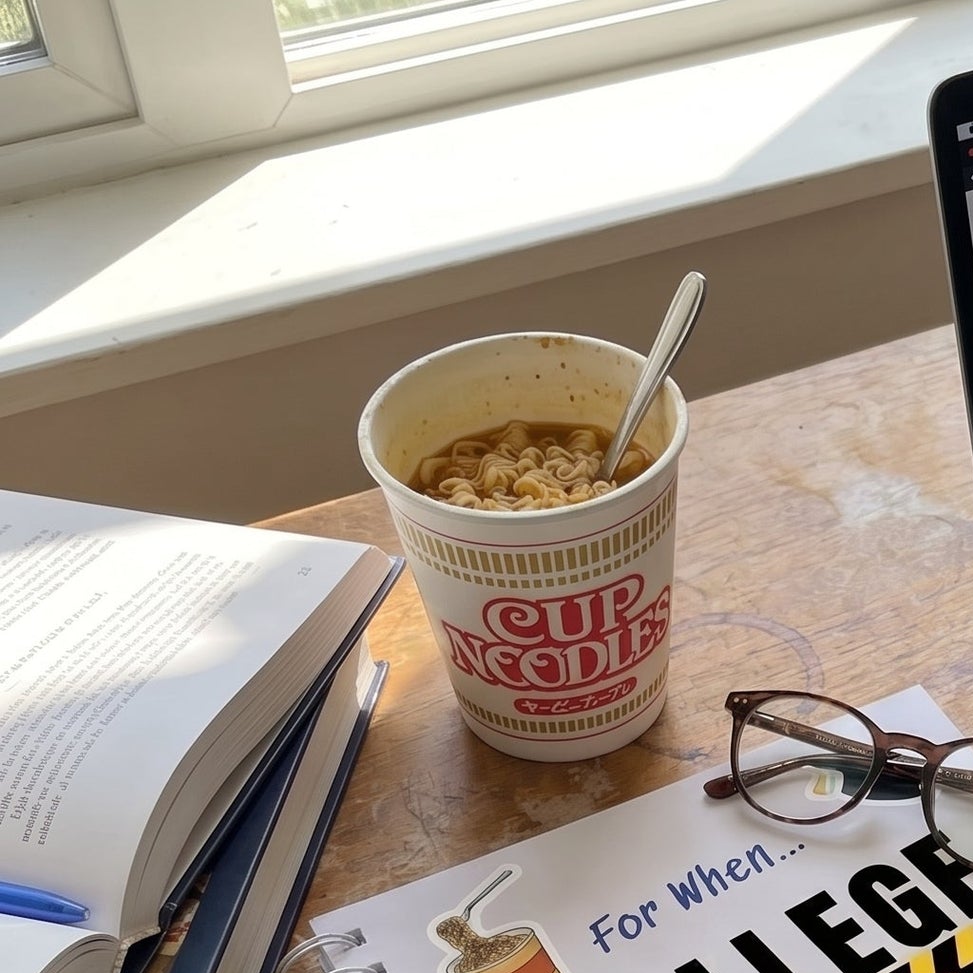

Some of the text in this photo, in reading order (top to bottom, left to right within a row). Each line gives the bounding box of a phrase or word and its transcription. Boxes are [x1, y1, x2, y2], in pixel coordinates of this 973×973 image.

[482, 573, 645, 647] CUP
[588, 843, 806, 954] For When...
